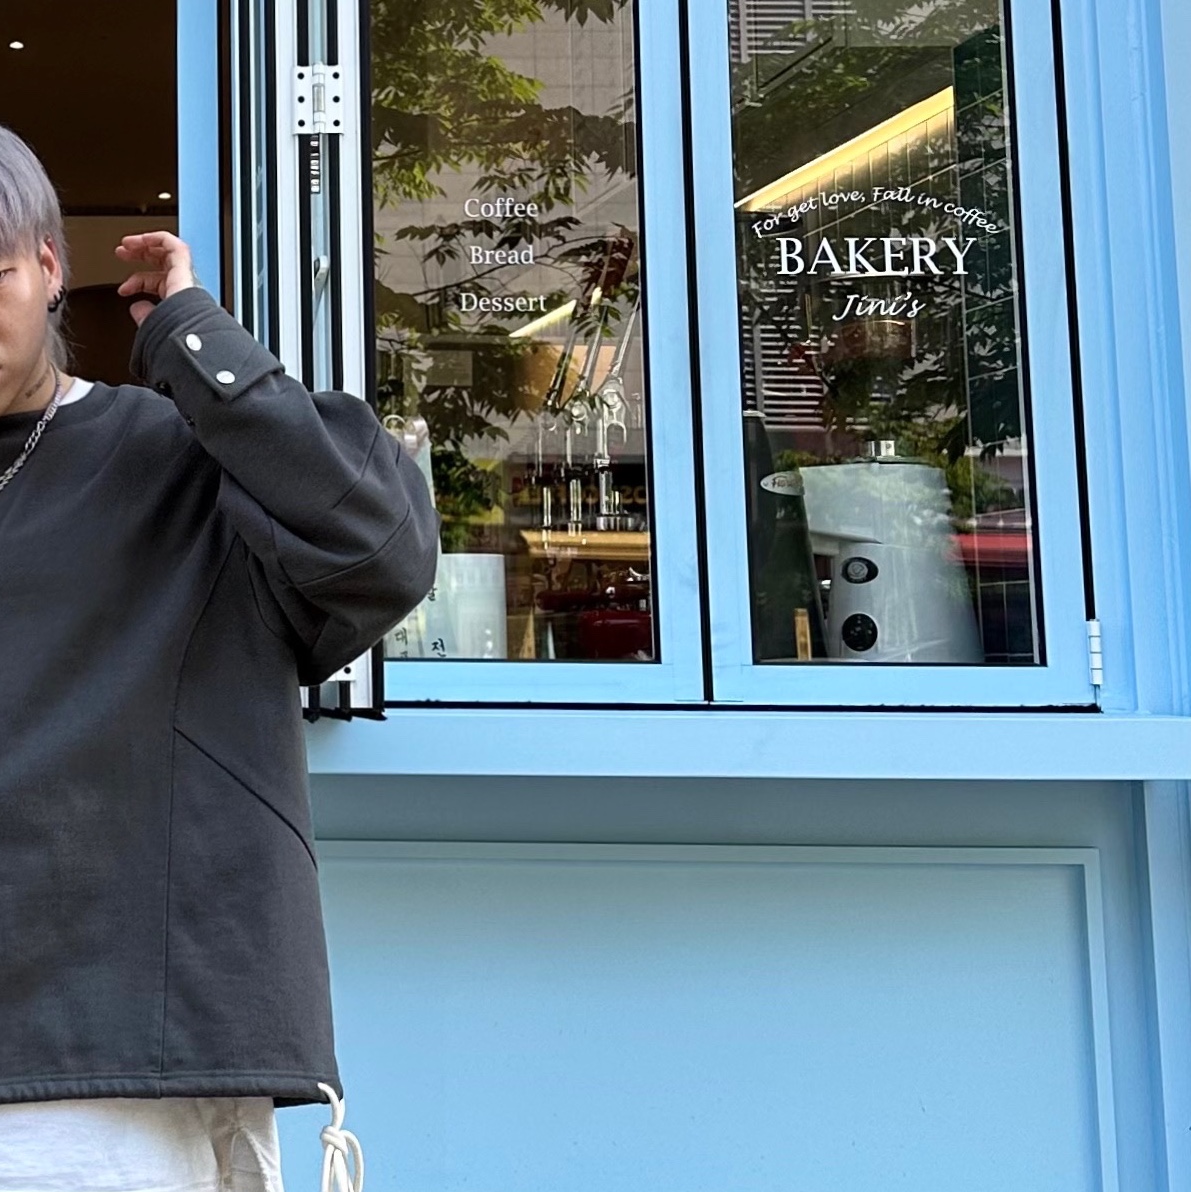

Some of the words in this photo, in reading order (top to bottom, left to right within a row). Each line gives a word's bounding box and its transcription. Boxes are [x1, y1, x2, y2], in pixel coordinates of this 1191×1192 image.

[464, 197, 539, 218] Coffee
[752, 214, 784, 239] For
[787, 199, 817, 222] get
[820, 189, 866, 207] love,
[872, 186, 915, 203] Fall
[917, 192, 943, 209] in
[944, 202, 1001, 234] coffee
[469, 244, 536, 265] Bread
[776, 237, 977, 276] BAKERY
[460, 292, 548, 312] Dessert
[832, 291, 927, 322] Jini's
